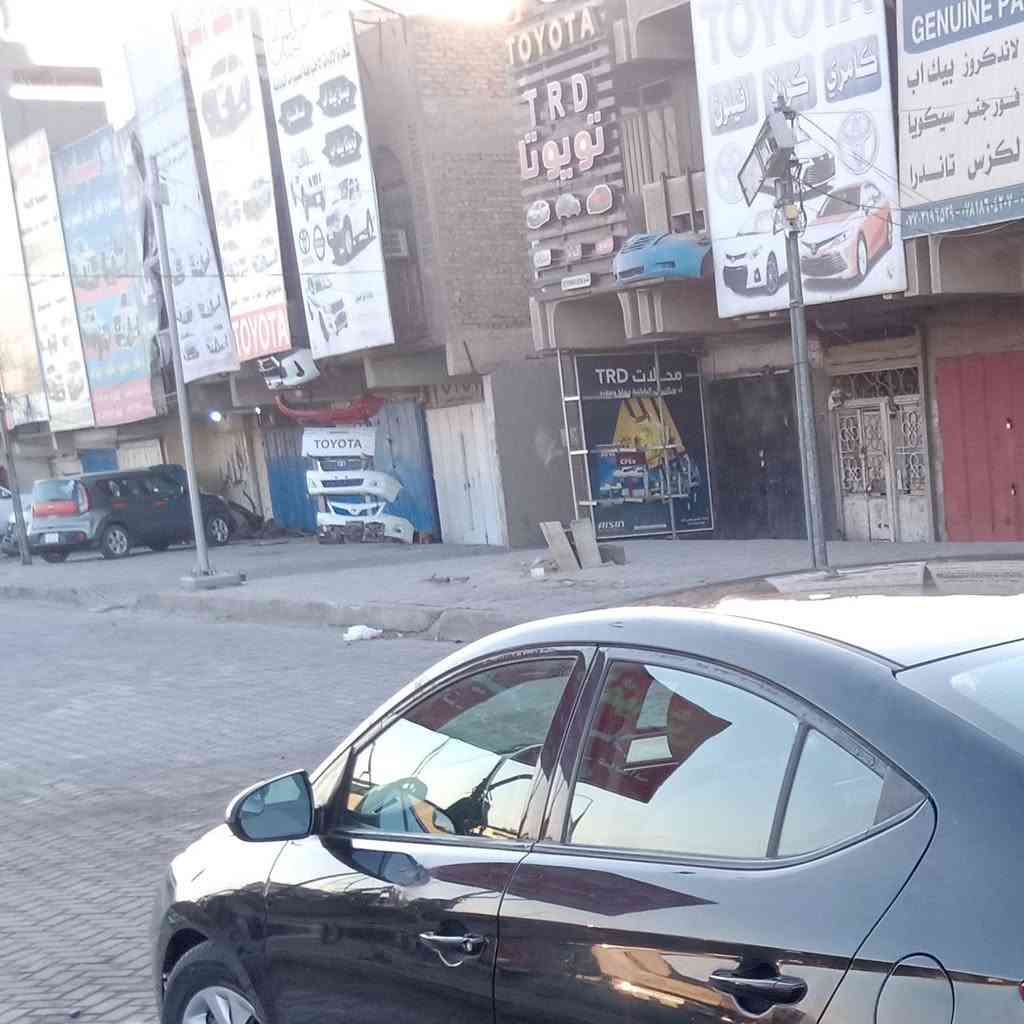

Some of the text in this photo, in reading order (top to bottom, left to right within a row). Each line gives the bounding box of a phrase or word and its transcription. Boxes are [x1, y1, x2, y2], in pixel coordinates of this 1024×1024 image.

[505, 7, 595, 64] TOYOTA
[911, 0, 993, 44] GENUINE
[962, 39, 1020, 77] لاندكروز
[521, 73, 588, 128] TRD
[907, 106, 955, 139] سيكويا
[518, 112, 605, 180] تويوتا
[967, 136, 1021, 180] لكزس
[232, 307, 289, 358] TOYOTA
[594, 368, 629, 384] TRD
[313, 439, 362, 449] TOYOTA
